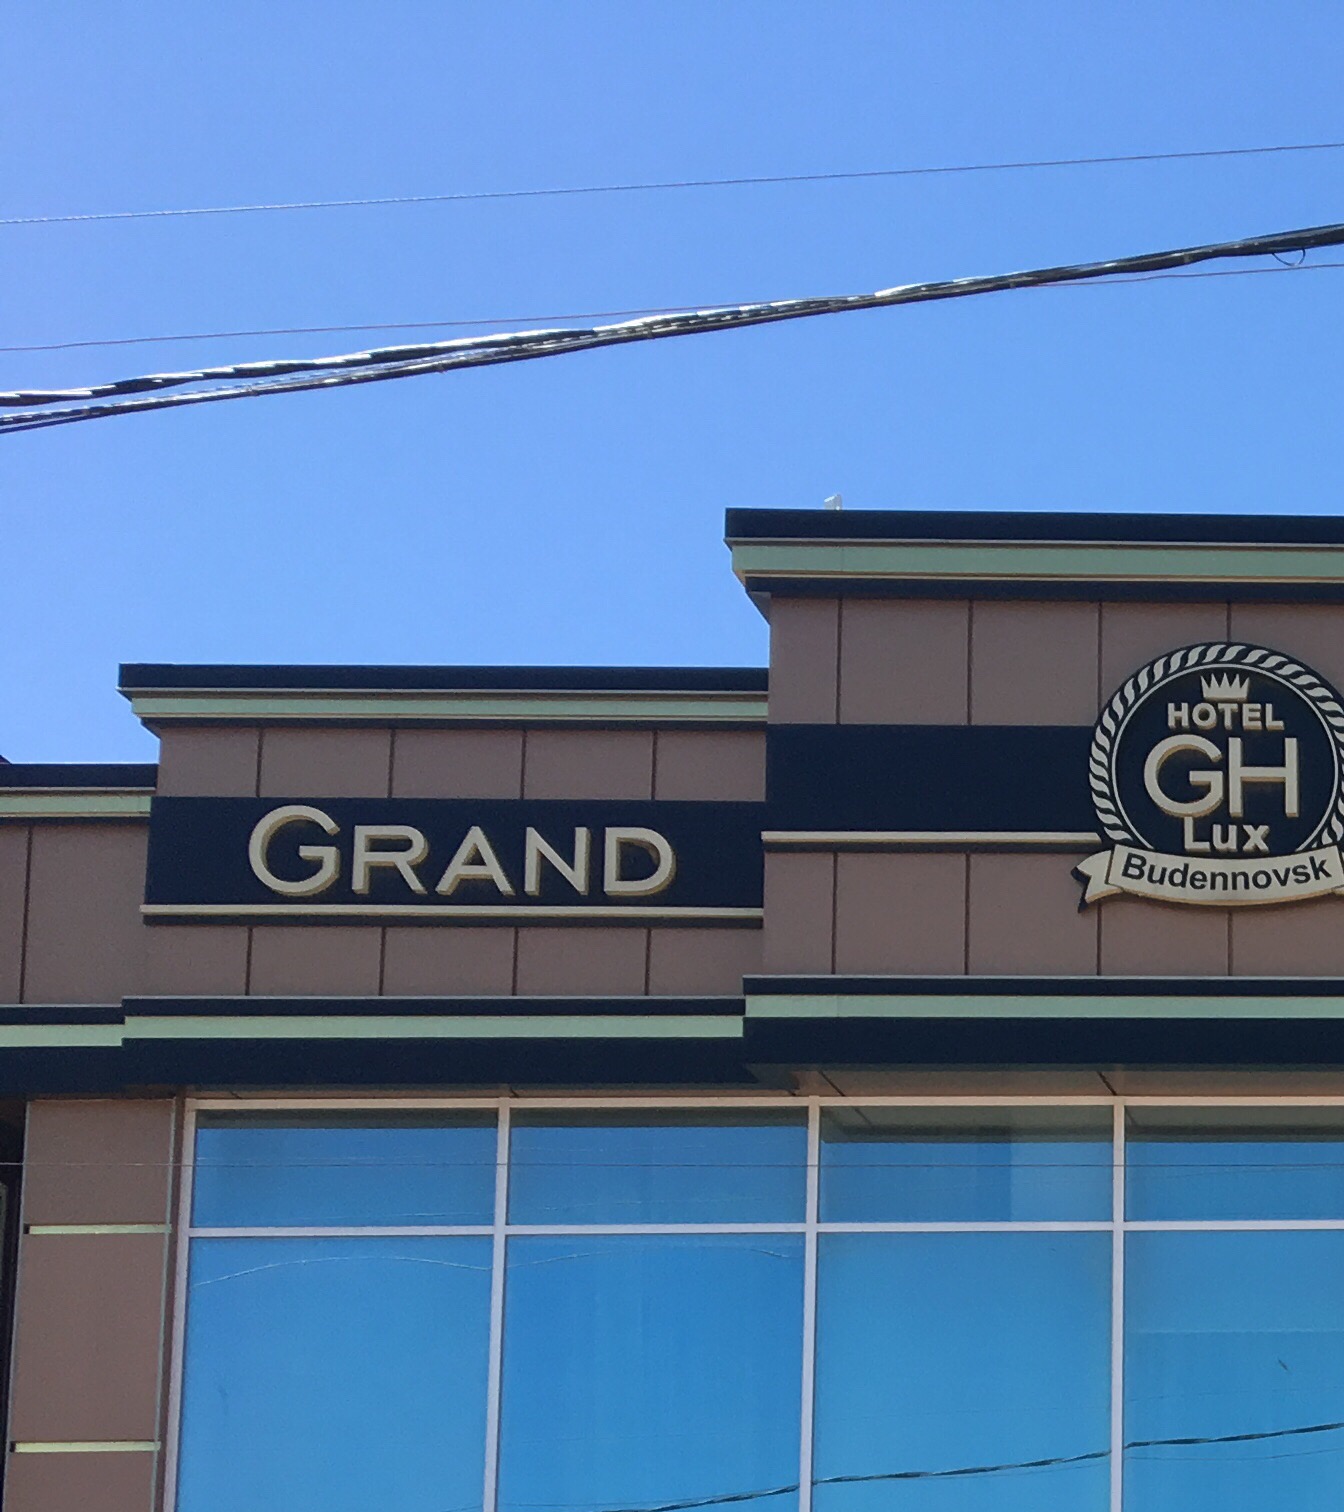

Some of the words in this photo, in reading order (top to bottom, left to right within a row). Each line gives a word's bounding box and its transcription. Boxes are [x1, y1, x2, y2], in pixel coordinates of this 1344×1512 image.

[1167, 702, 1285, 731] HOTEL
[1143, 733, 1300, 819] GH
[247, 804, 678, 897] GRAND
[1121, 851, 1334, 892] Budennovsk
